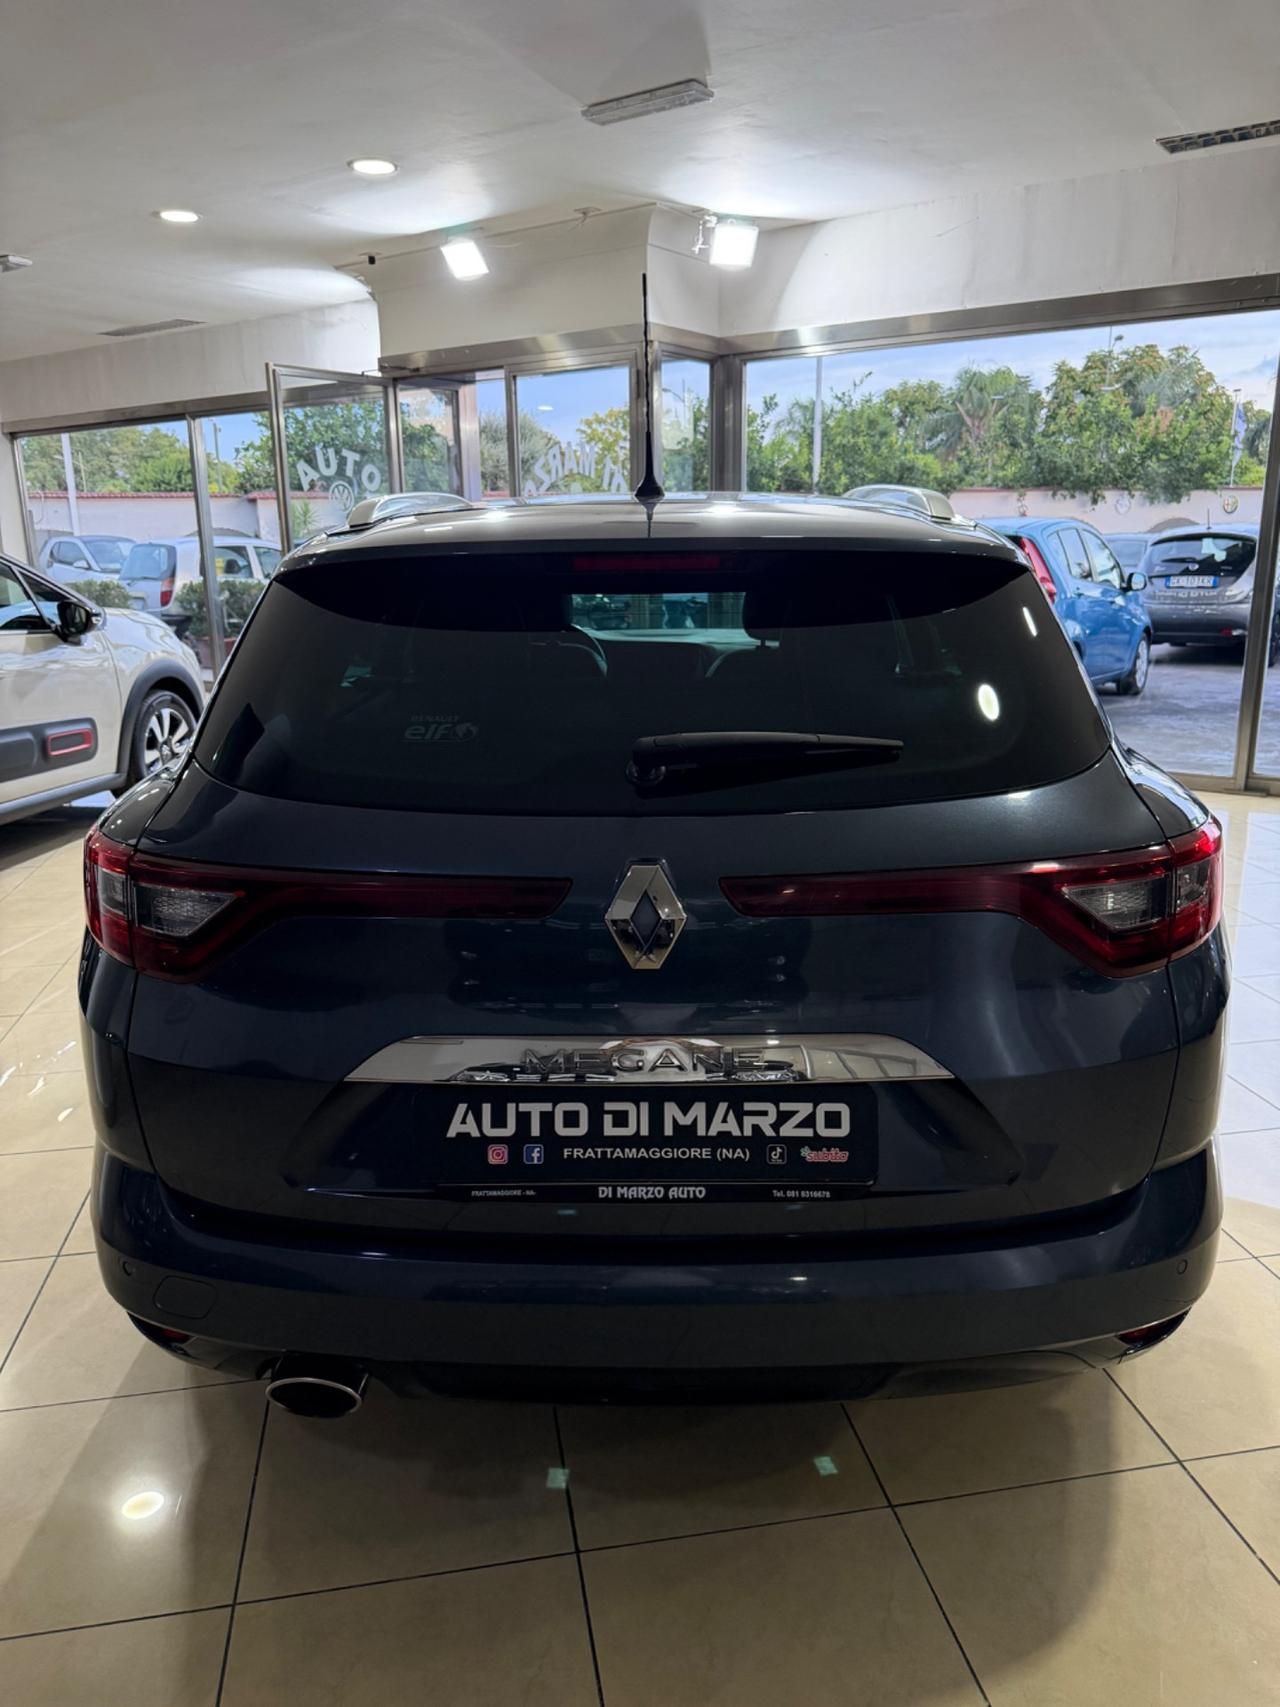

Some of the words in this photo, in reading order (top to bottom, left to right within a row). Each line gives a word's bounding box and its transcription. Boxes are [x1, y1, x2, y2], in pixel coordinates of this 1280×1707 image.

[296, 443, 382, 492] AUTO
[523, 1048, 766, 1073] MEGANE
[446, 1101, 589, 1138] AUTO
[603, 1101, 649, 1137] DI
[663, 1101, 851, 1137] MARZO
[563, 1146, 712, 1160] FRATTAMAGGIORE
[716, 1147, 750, 1161] (NA)
[598, 1186, 613, 1200] DI
[617, 1186, 665, 1200] MARZO
[668, 1186, 706, 1199] AUTO
